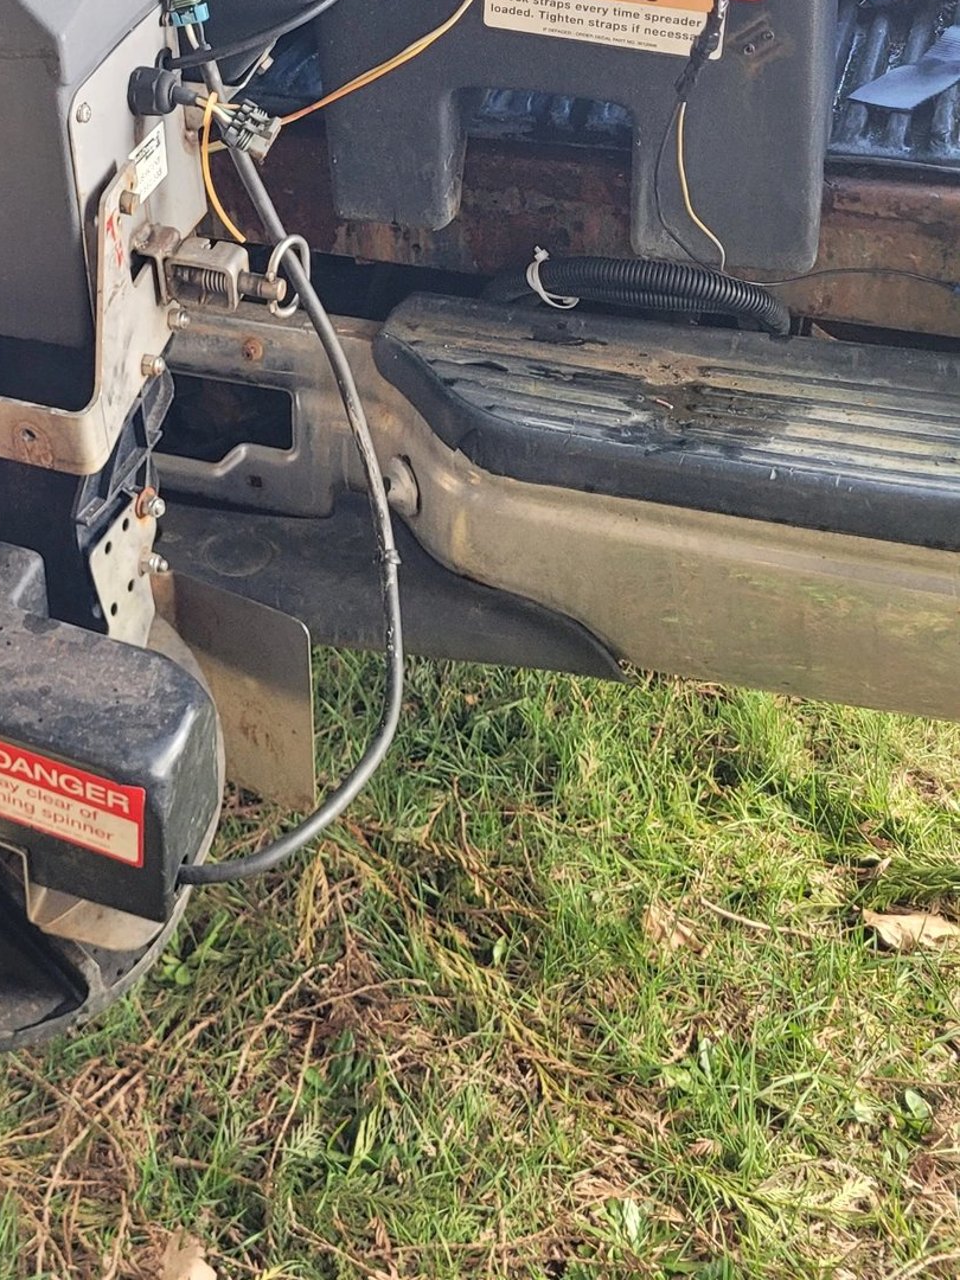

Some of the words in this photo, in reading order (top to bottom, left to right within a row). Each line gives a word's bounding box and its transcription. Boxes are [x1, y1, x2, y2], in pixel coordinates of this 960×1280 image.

[491, 4, 534, 18] loaded.
[539, 10, 584, 26] Tighten
[588, 18, 628, 33] straps
[632, 23, 640, 34] if
[575, 3, 609, 17] every
[613, 5, 640, 20] time
[644, 13, 702, 28] spreader
[26, 786, 73, 810] clear
[80, 806, 99, 821] of
[42, 807, 114, 841] spinner
